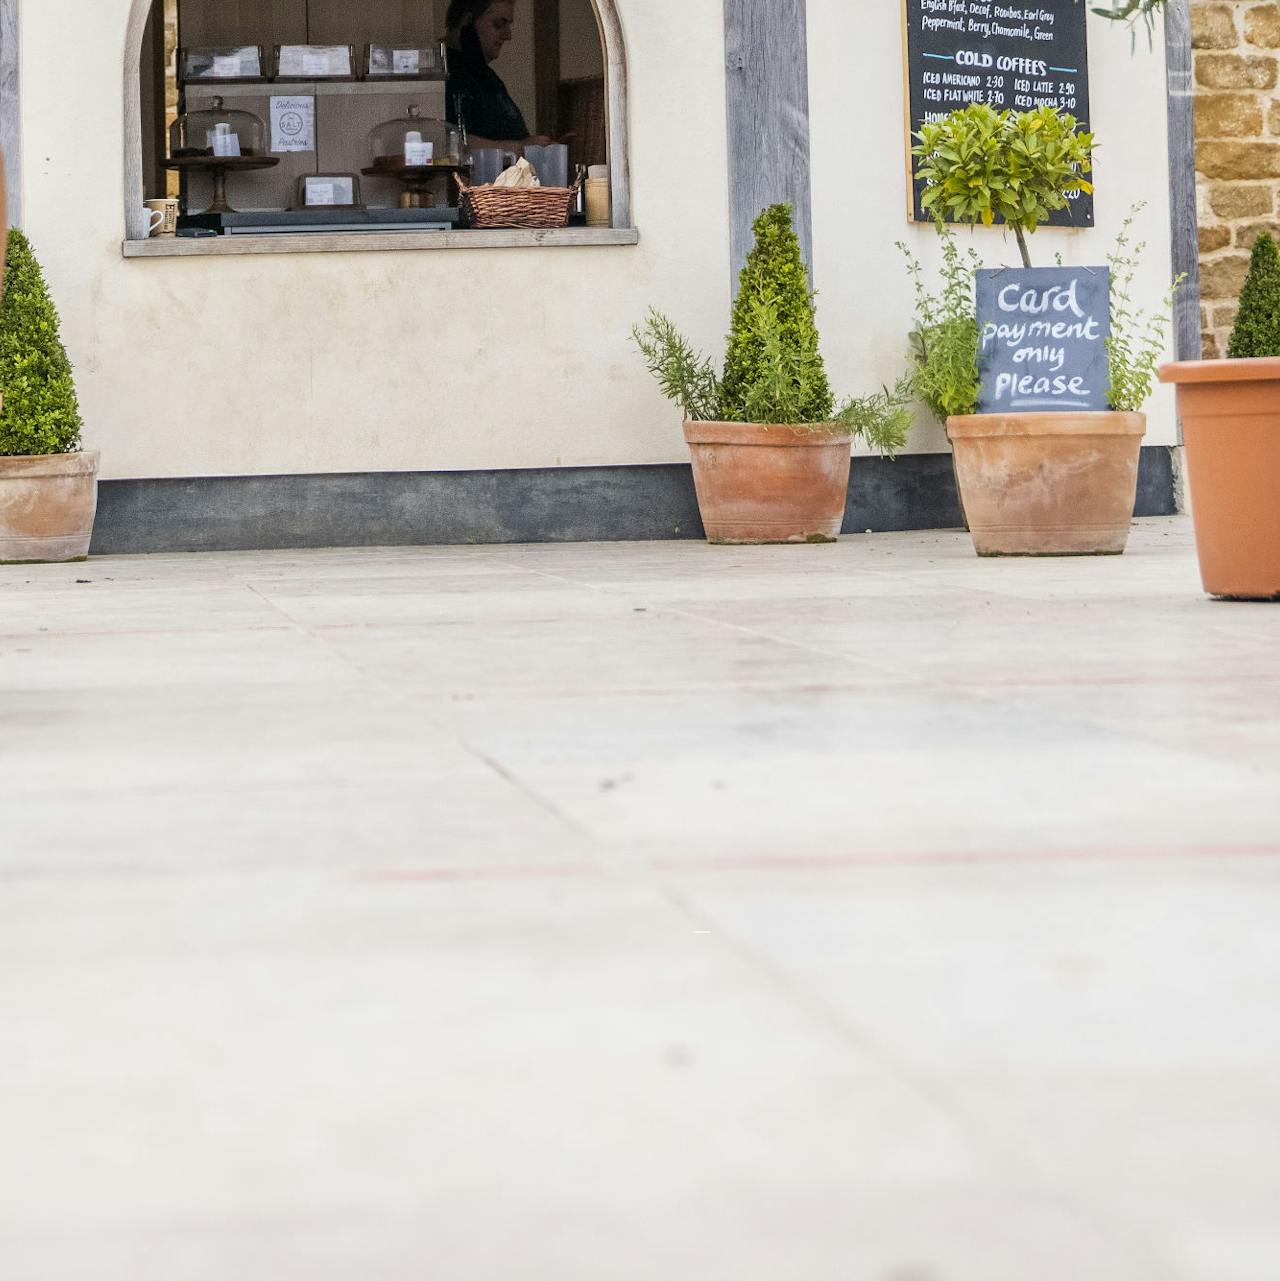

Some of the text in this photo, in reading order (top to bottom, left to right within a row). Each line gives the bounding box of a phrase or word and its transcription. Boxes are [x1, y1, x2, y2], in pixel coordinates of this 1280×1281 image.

[1024, 9, 1039, 20] Earl
[1039, 10, 1055, 25] Grey
[1034, 26, 1054, 41] Green
[955, 50, 1047, 76] COLD COFFEES
[923, 71, 940, 84] ICED
[942, 72, 981, 87] AMERICANO
[1014, 78, 1030, 93] ICED
[1033, 81, 1054, 93] LATTE
[923, 88, 942, 102] ICED
[944, 89, 961, 101] FLAT
[962, 90, 984, 102] WHITE
[1015, 94, 1032, 107] ICED
[998, 279, 1085, 318] Card
[982, 316, 1100, 350] payment
[1012, 345, 1065, 371] only
[995, 372, 1091, 400] Please
